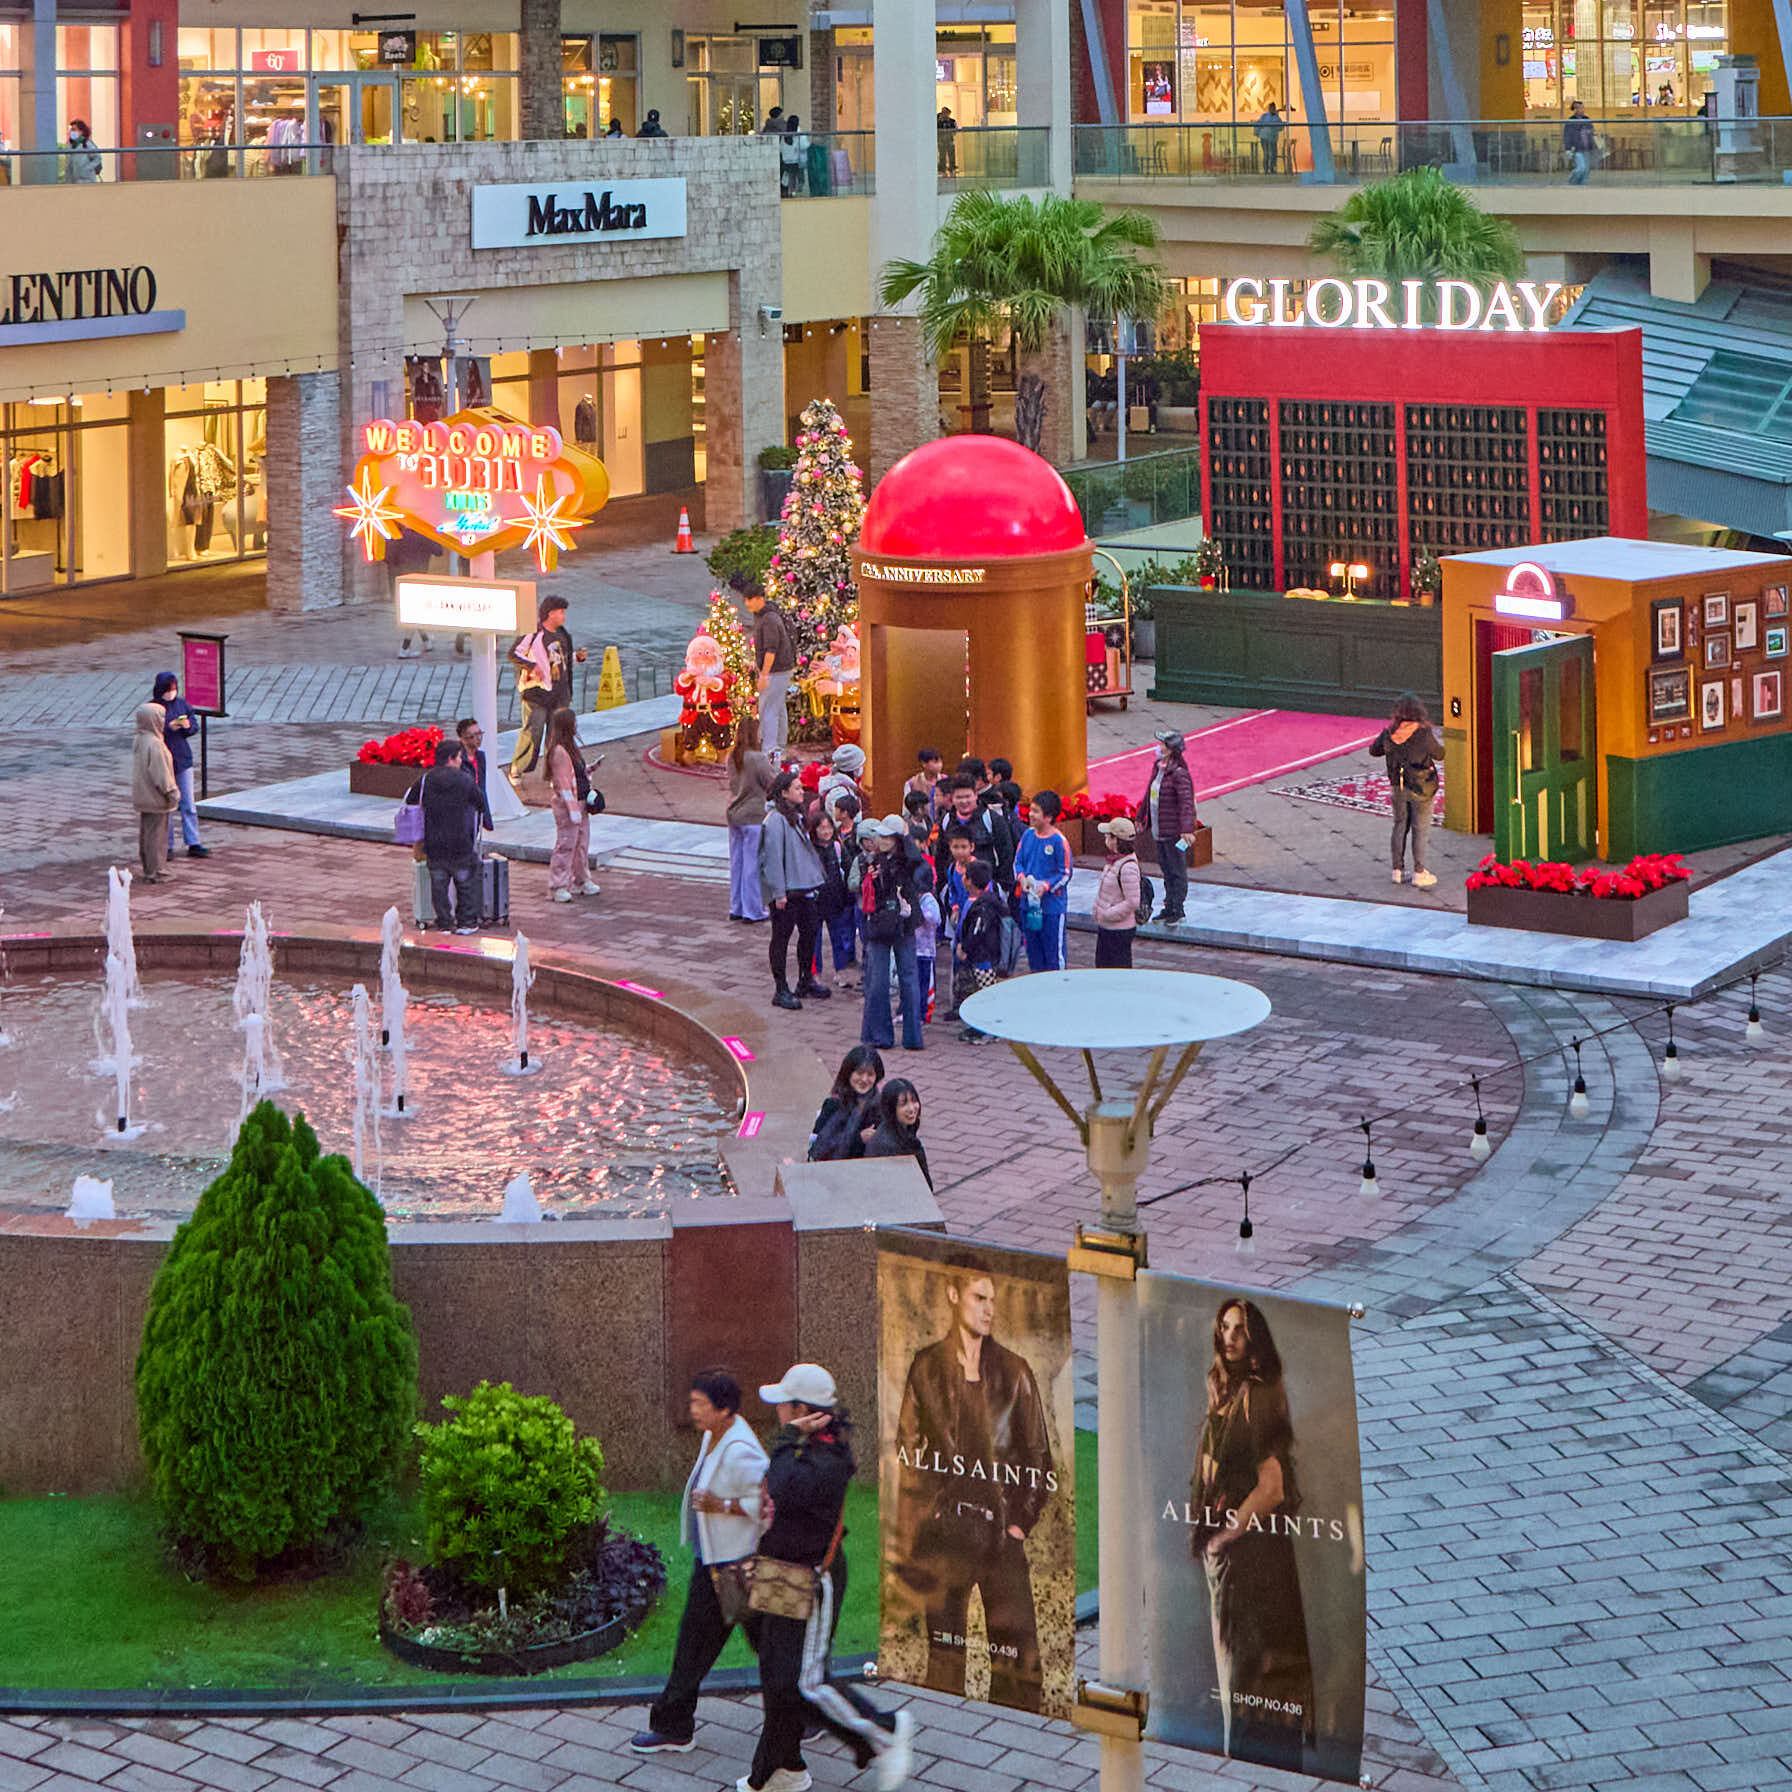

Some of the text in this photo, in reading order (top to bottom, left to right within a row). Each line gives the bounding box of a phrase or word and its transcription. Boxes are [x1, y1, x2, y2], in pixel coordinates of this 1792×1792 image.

[526, 191, 648, 236] MaxMara
[1225, 276, 1562, 332] GLORIDAY
[365, 426, 546, 458] WELCOME
[882, 566, 986, 584] ANNIVERSARY
[895, 1445, 1059, 1492] ALLSAINTS
[1161, 1499, 1345, 1540] ALLSAINTS
[1233, 1692, 1264, 1707] SHOP
[1264, 1698, 1303, 1716] NO.436
